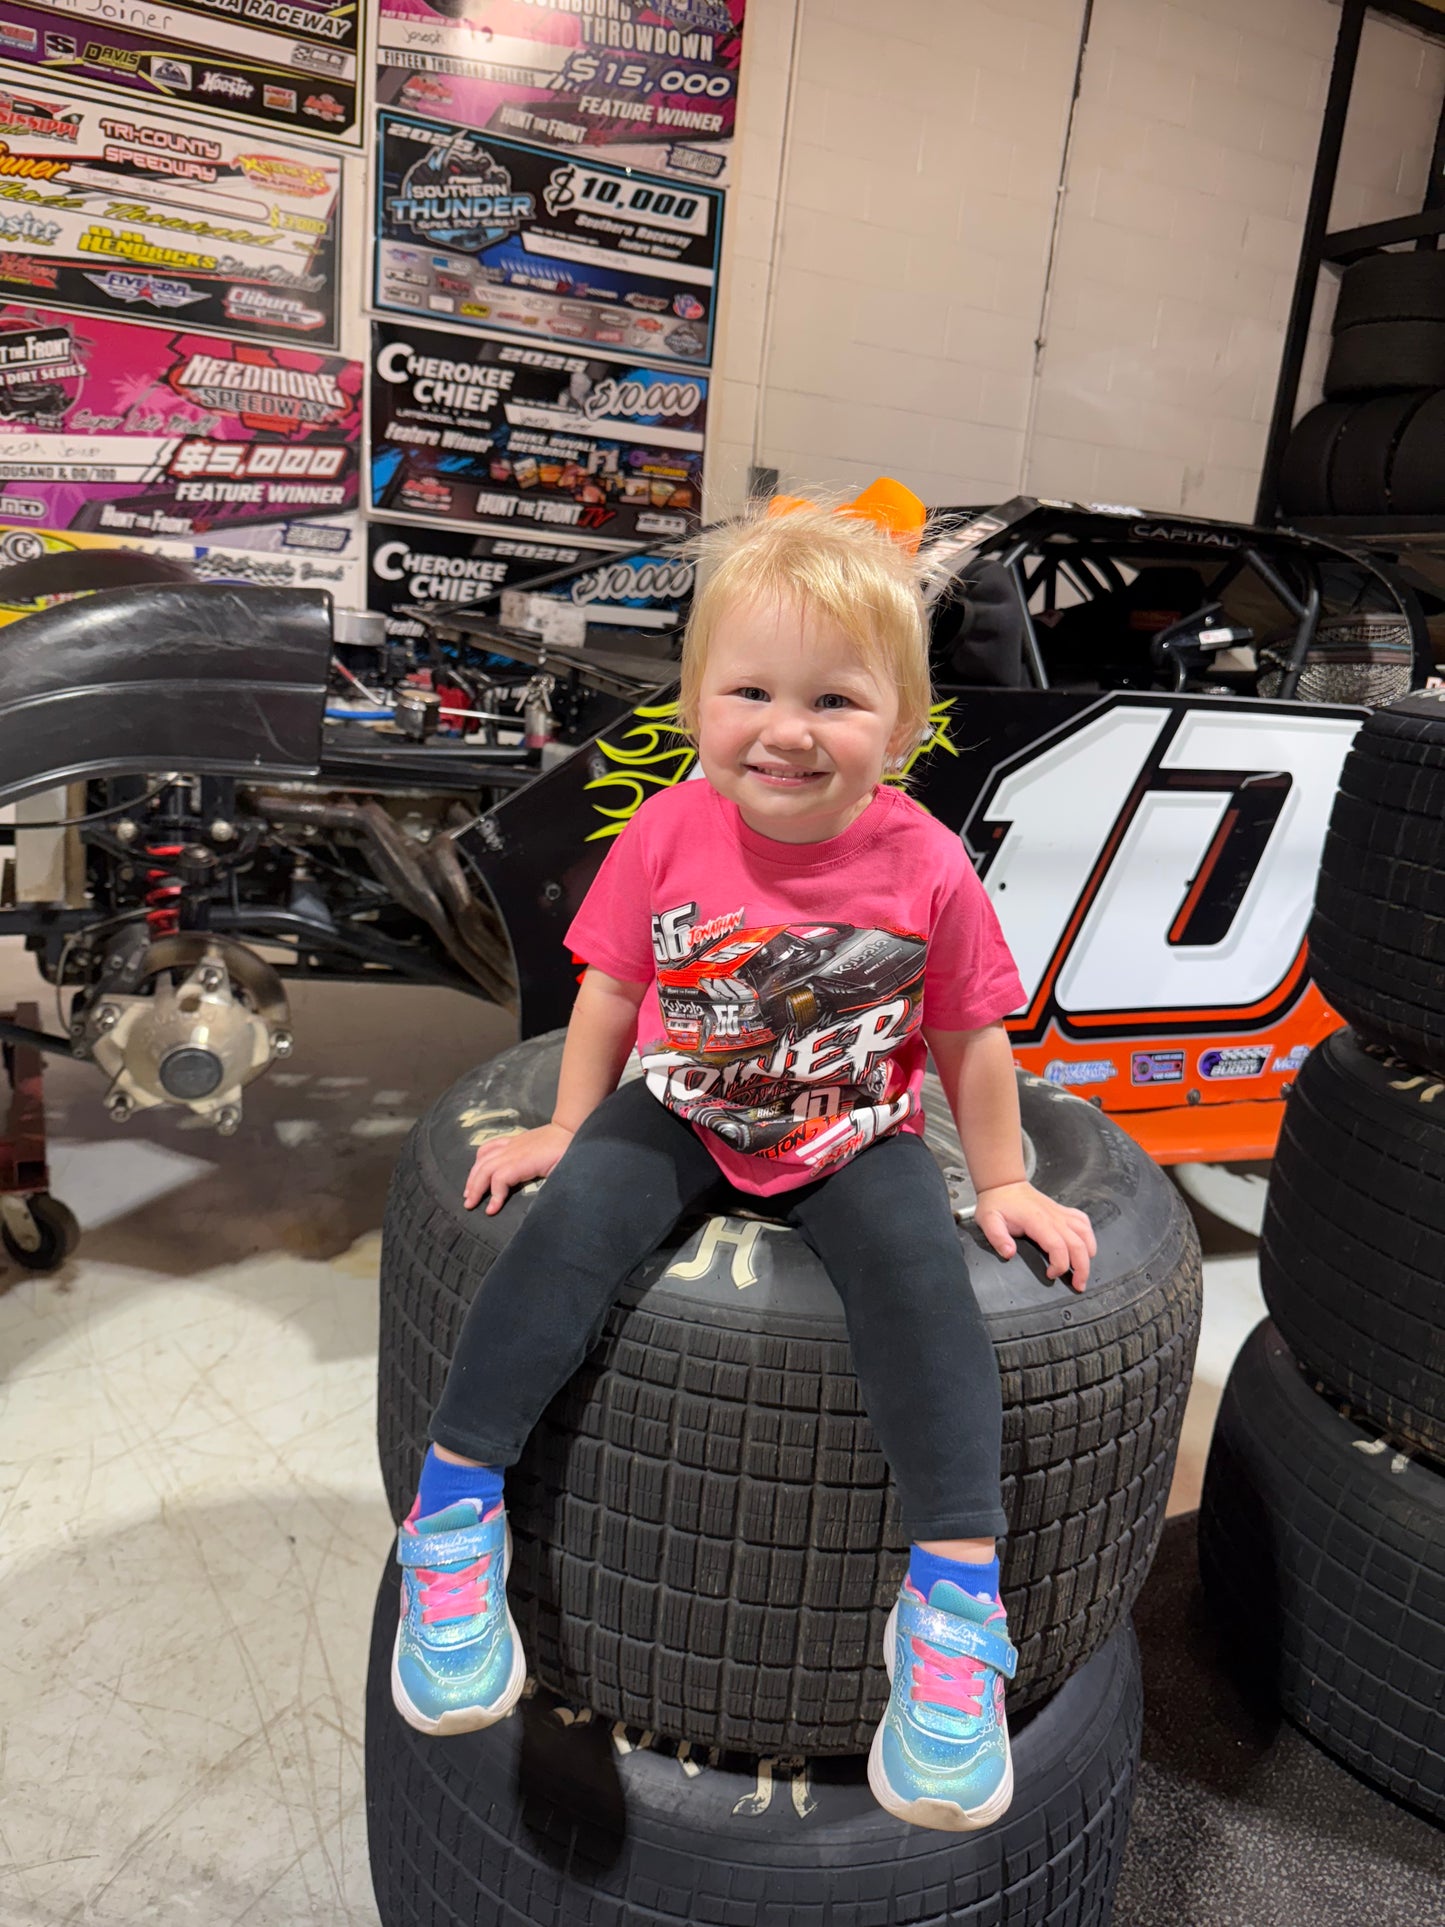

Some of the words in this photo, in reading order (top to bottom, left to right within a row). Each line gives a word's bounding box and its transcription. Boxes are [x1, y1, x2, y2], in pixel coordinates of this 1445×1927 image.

[245, 0, 352, 39] RACEWAY
[83, 42, 140, 67] DAVIS
[582, 16, 713, 62] THROWDOWN
[384, 50, 428, 71] FIFTEEN
[430, 56, 487, 80] THOUSAND
[500, 107, 535, 130] HUNT
[547, 118, 588, 145] FRONT
[578, 95, 654, 123] FEATURE
[656, 106, 724, 133] WINNER
[100, 119, 220, 158] TRI-COUNTY
[387, 122, 477, 154] 2025
[104, 146, 217, 182] SPEEDWAY
[411, 184, 509, 199] SOUTHERN
[391, 196, 532, 221] THUNDER
[78, 233, 218, 270] HENDRICKS
[6, 370, 38, 385] DIRT
[41, 363, 87, 381] SERIES
[498, 347, 590, 373] 2025
[178, 354, 348, 409] NEEDMORE
[413, 378, 500, 413] CHIEF
[203, 389, 326, 422] SPEEDWAY
[172, 443, 346, 475] $5,000
[175, 482, 264, 502] FEATURE
[267, 484, 345, 504] WINNER
[100, 505, 137, 527] HUNT
[475, 492, 520, 518] HUNT
[517, 503, 536, 518] THE
[533, 500, 584, 527] FRONT
[1133, 522, 1239, 549] CAPITAL
[491, 541, 581, 564] 2025
[982, 705, 1364, 1016] 10
[652, 902, 695, 964] 56
[687, 907, 745, 947] JONATHAN
[661, 999, 704, 1017] Kubota
[757, 1103, 782, 1119] BASE
